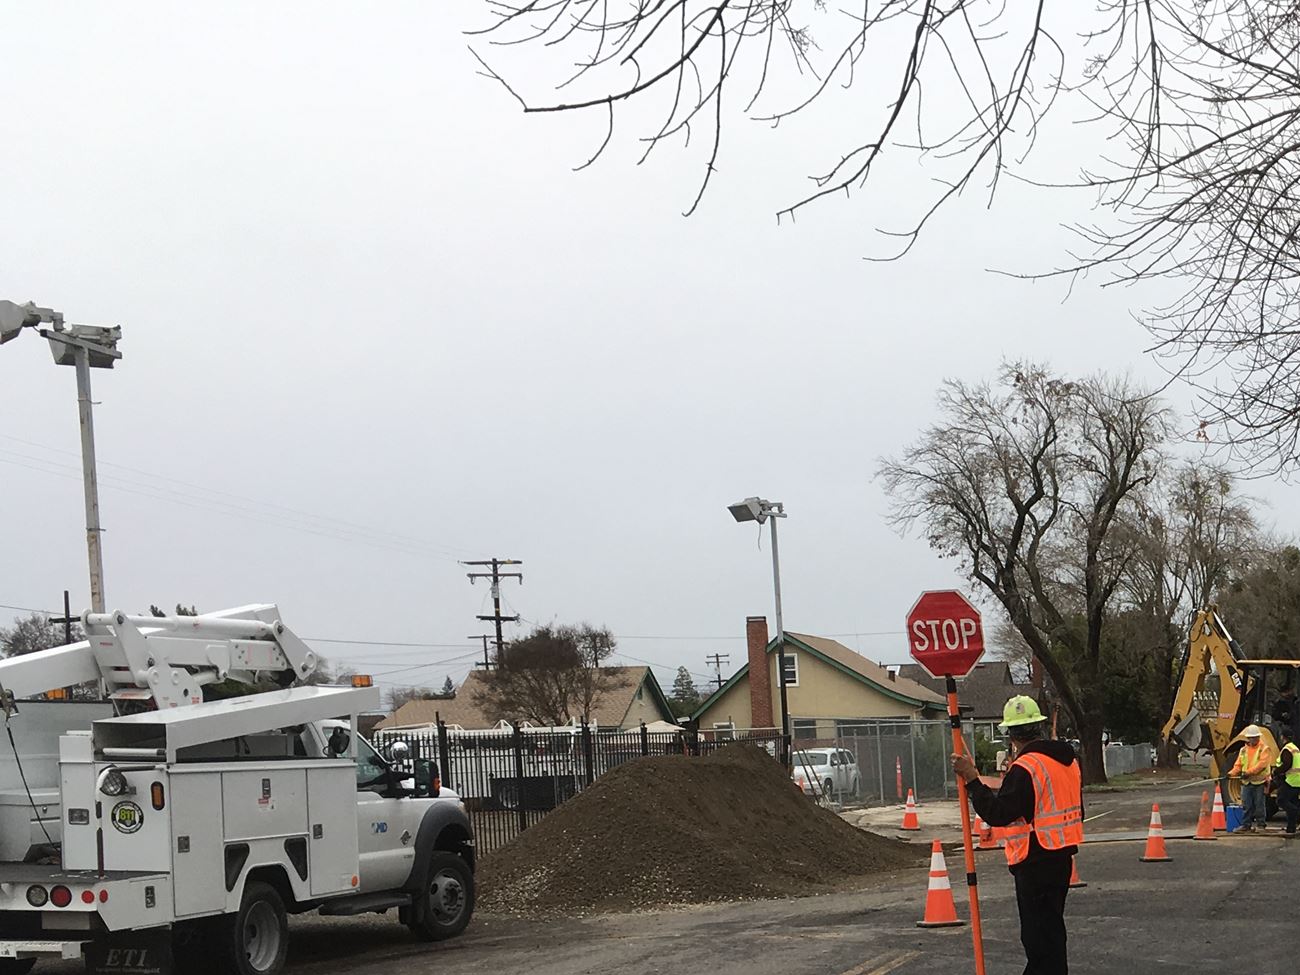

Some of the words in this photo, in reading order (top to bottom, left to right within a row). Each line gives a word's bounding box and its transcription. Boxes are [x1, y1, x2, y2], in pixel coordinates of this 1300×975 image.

[912, 618, 977, 651] STOP
[1231, 672, 1242, 688] CAT
[120, 808, 135, 820] 811
[106, 949, 148, 967] ETI
